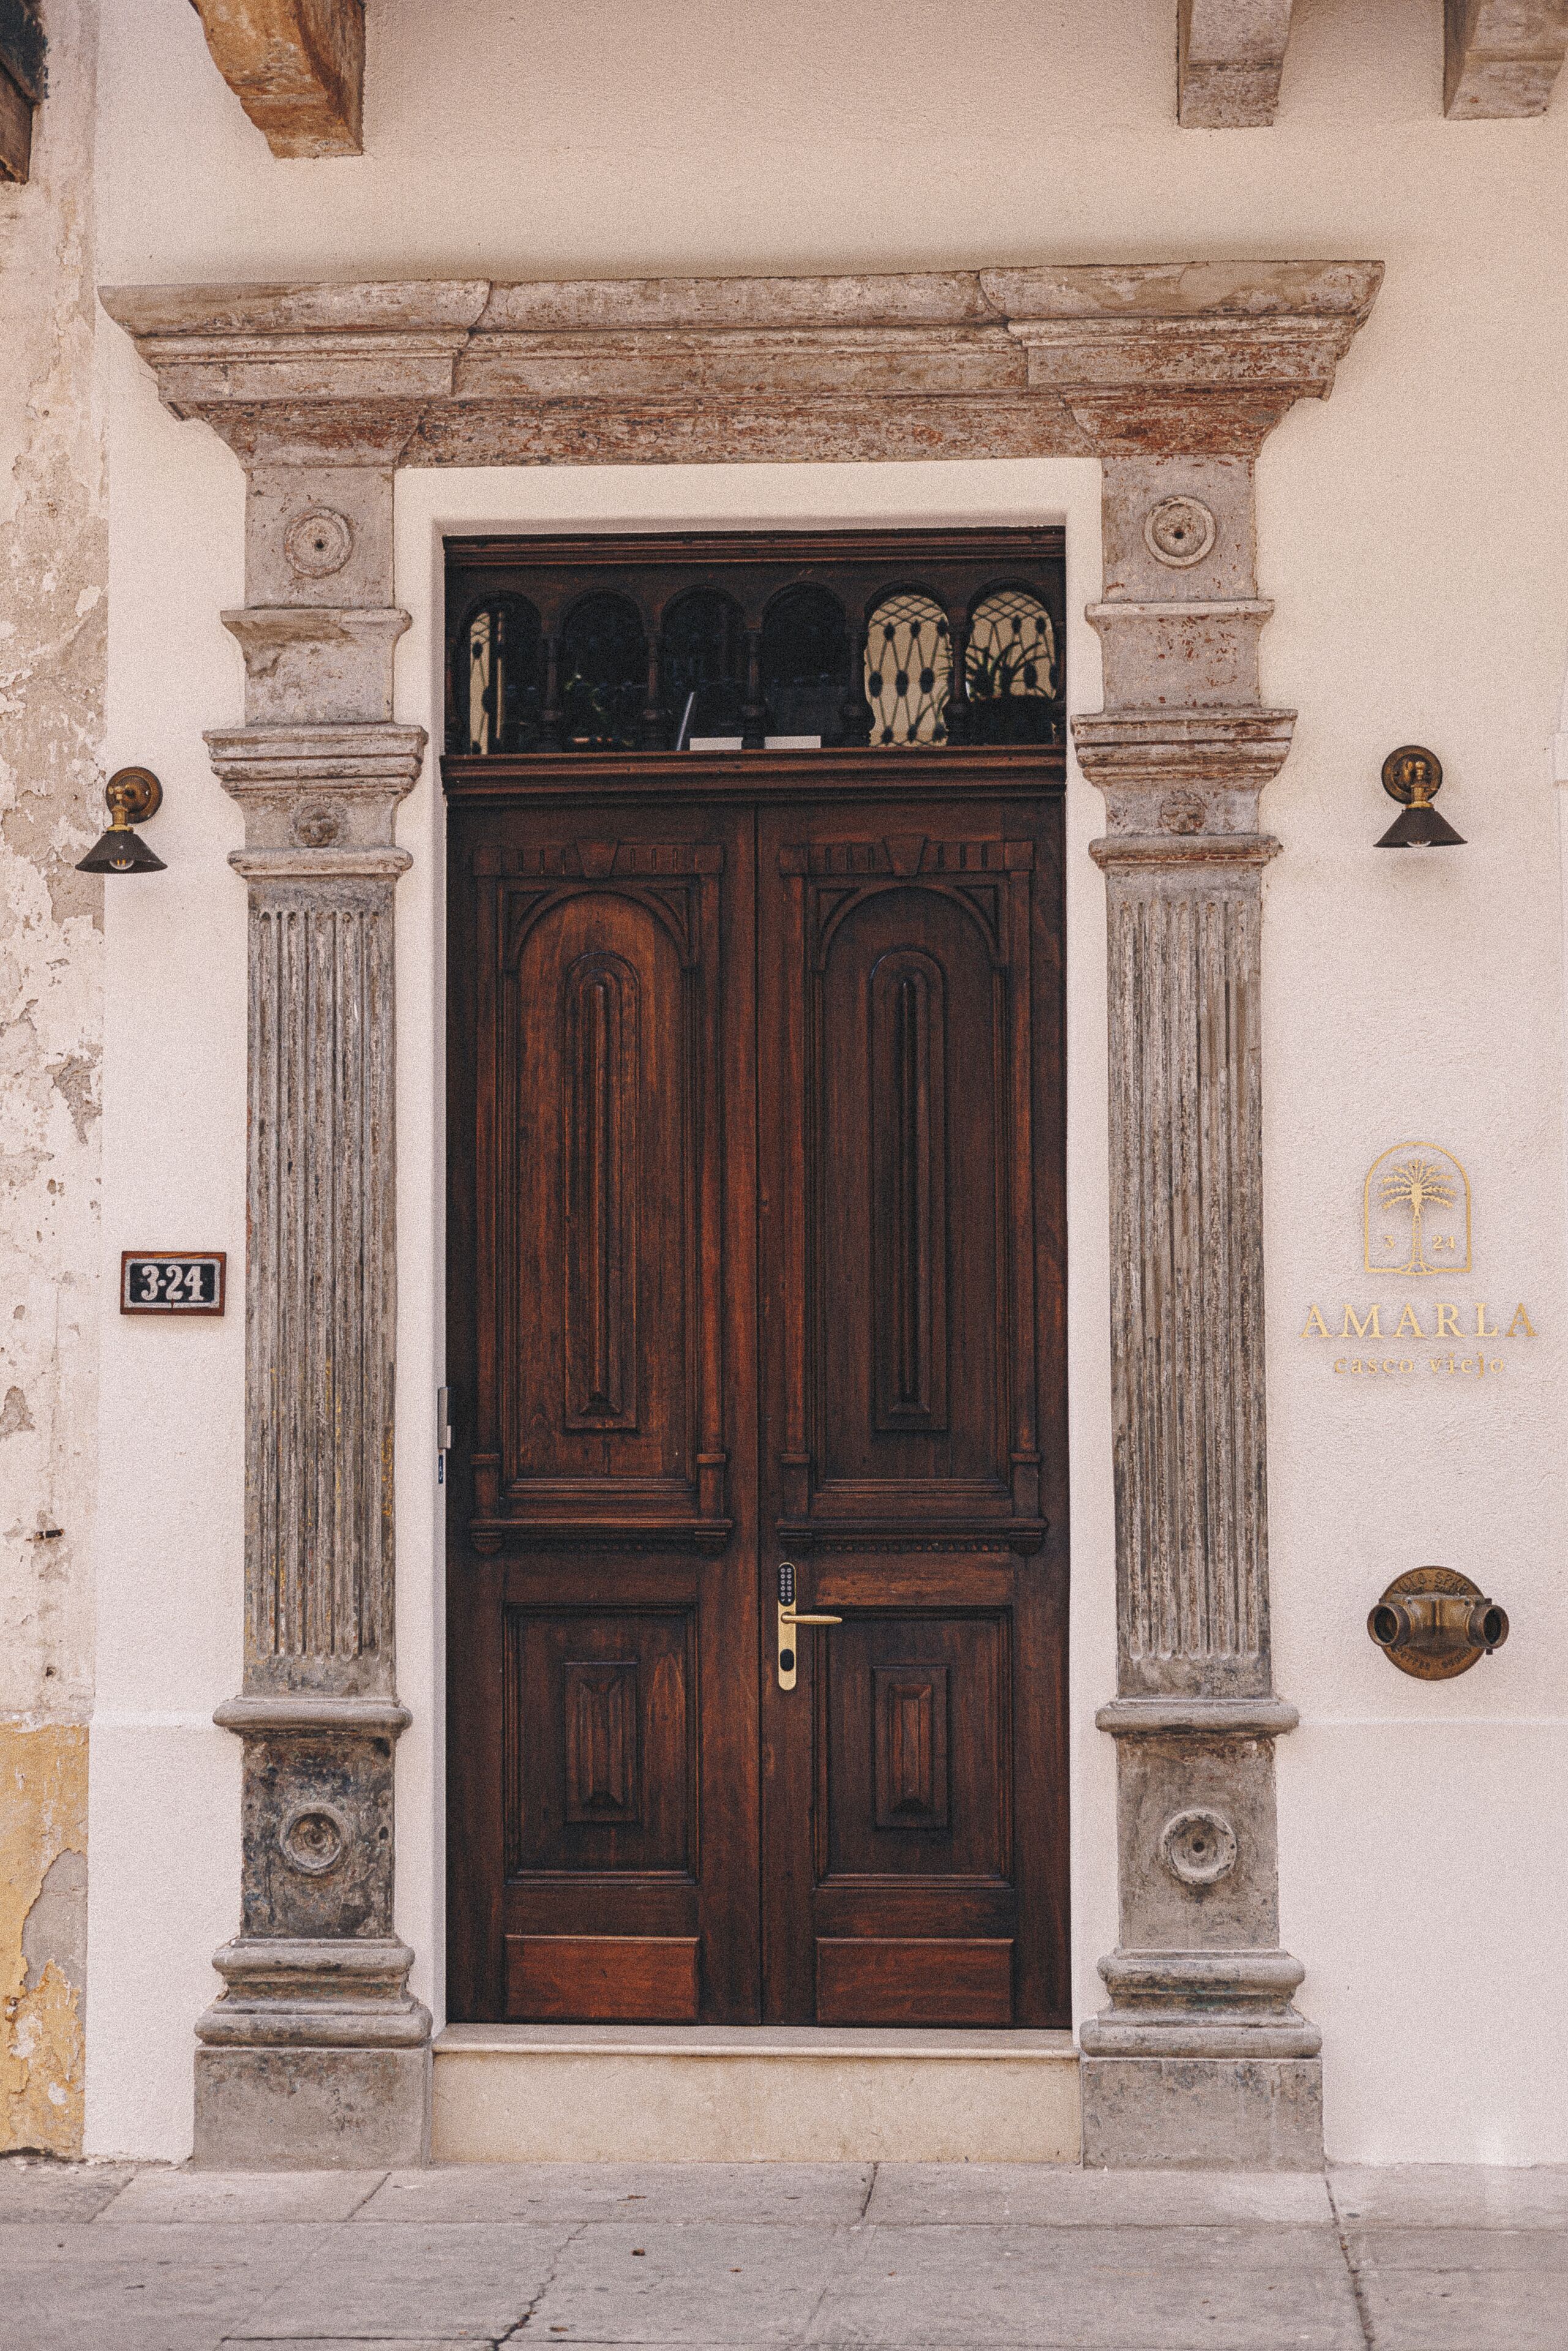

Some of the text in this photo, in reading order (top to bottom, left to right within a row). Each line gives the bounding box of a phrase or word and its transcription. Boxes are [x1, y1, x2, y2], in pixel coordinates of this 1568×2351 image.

[1384, 1235, 1455, 1249] 3 24
[141, 1265, 204, 1301] 3-24
[1299, 1302, 1538, 1338] AMARLA
[1334, 1351, 1505, 1378] casco viejo
